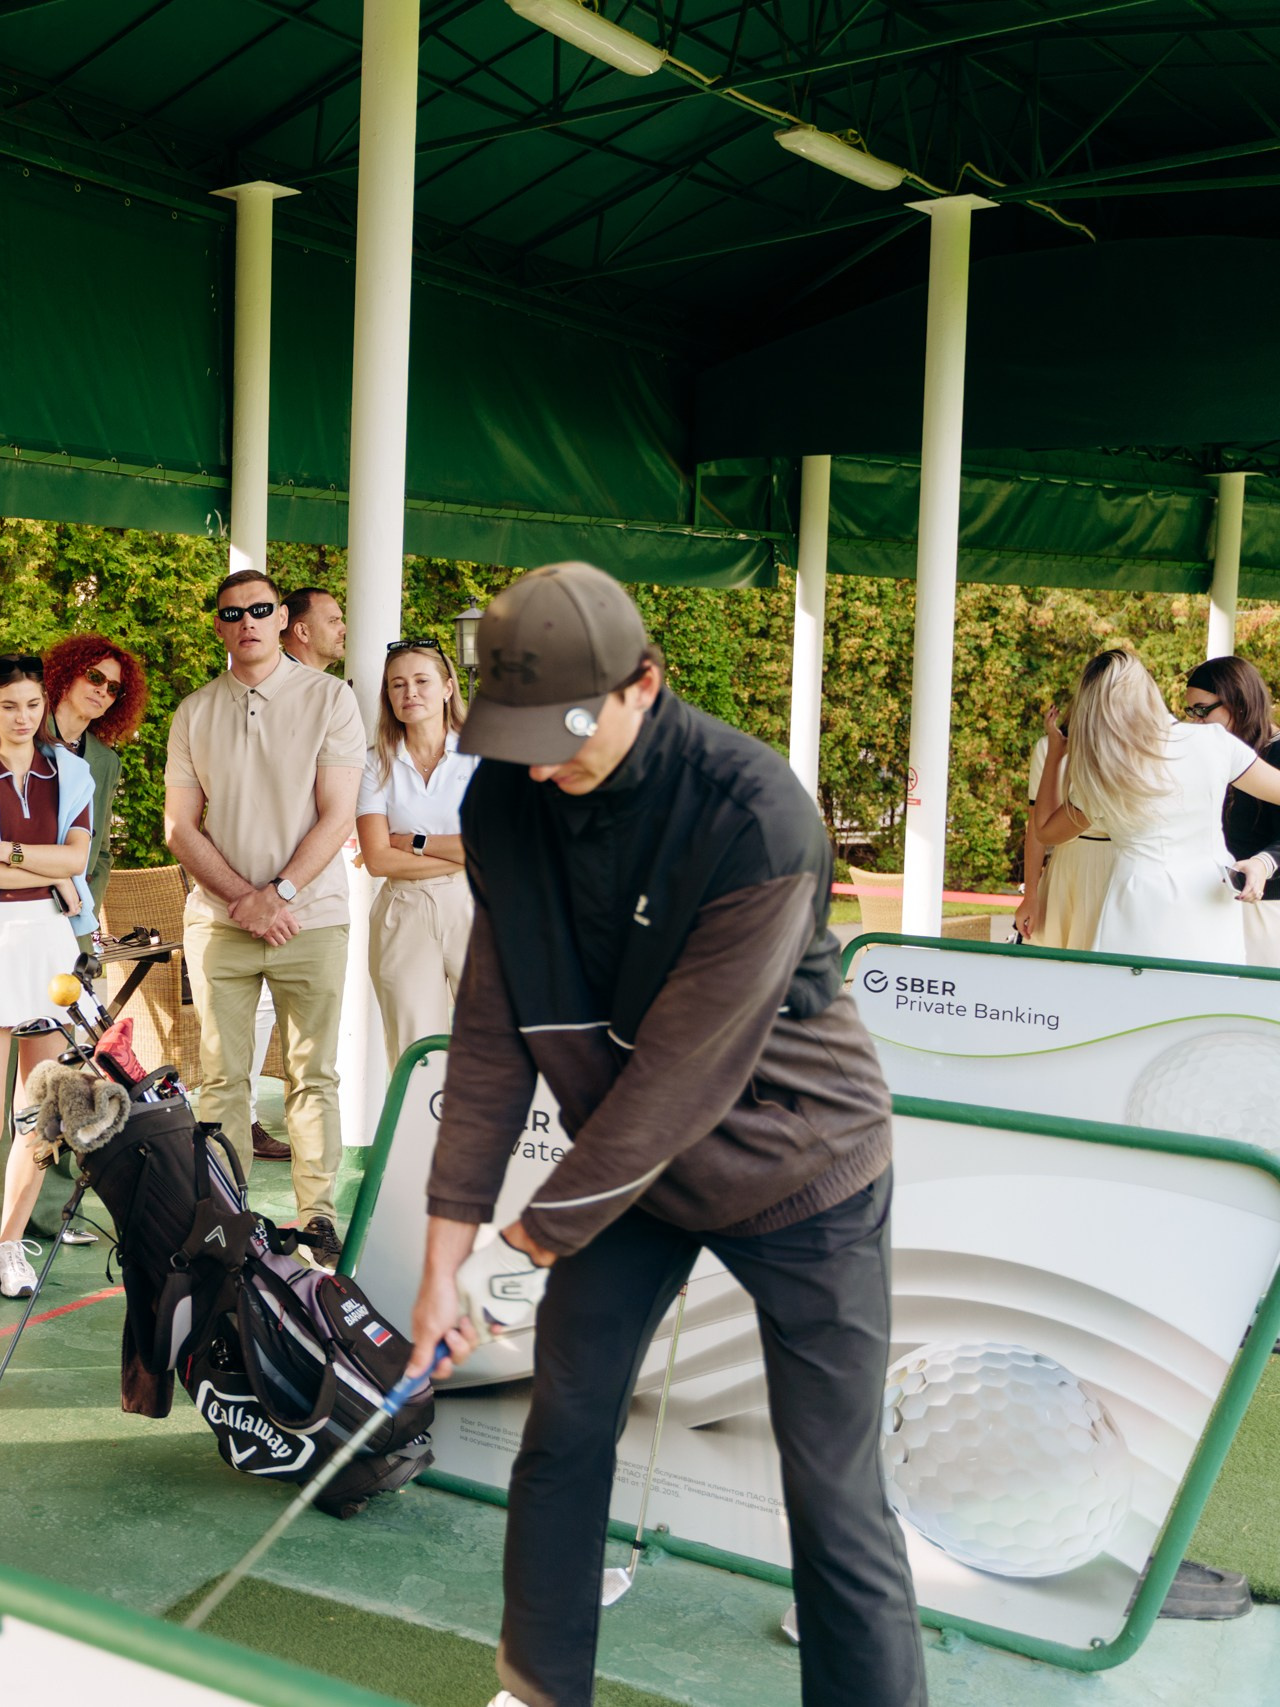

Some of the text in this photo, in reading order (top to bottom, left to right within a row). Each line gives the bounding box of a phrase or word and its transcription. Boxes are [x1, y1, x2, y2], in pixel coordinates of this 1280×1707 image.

[895, 976, 956, 997] SBER
[896, 995, 1060, 1031] Private Banking
[511, 1140, 567, 1164] vate
[207, 1400, 293, 1459] Callaway
